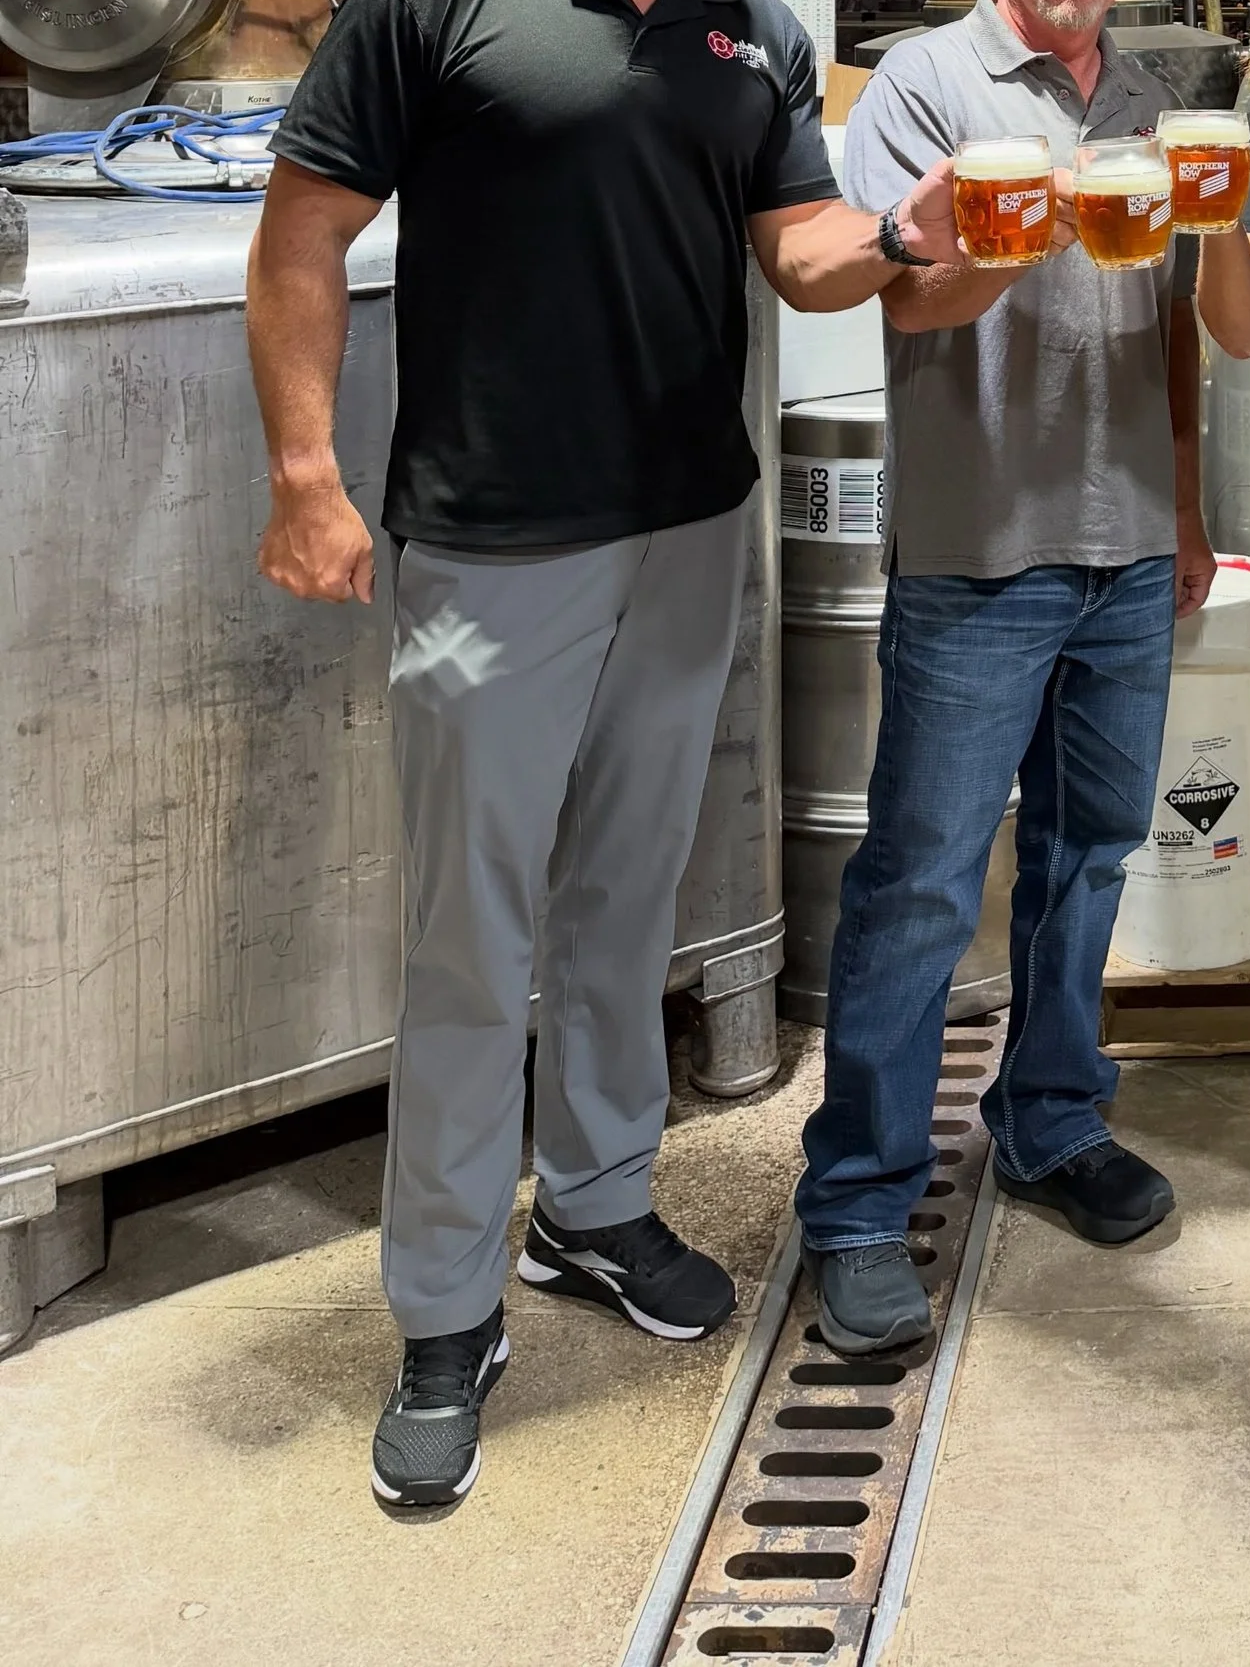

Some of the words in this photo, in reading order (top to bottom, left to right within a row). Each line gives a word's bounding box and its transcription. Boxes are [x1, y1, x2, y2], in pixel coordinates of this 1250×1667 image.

[1178, 161, 1230, 171] NORTHERN
[1178, 169, 1201, 179] ROW
[997, 188, 1048, 203] NORTHERN
[998, 199, 1022, 211] ROW
[1128, 201, 1151, 213] ROW
[810, 467, 829, 534] 85003
[1169, 784, 1236, 805] CORROSIVE
[1200, 817, 1210, 829] 8
[1152, 830, 1195, 841] UN3262
